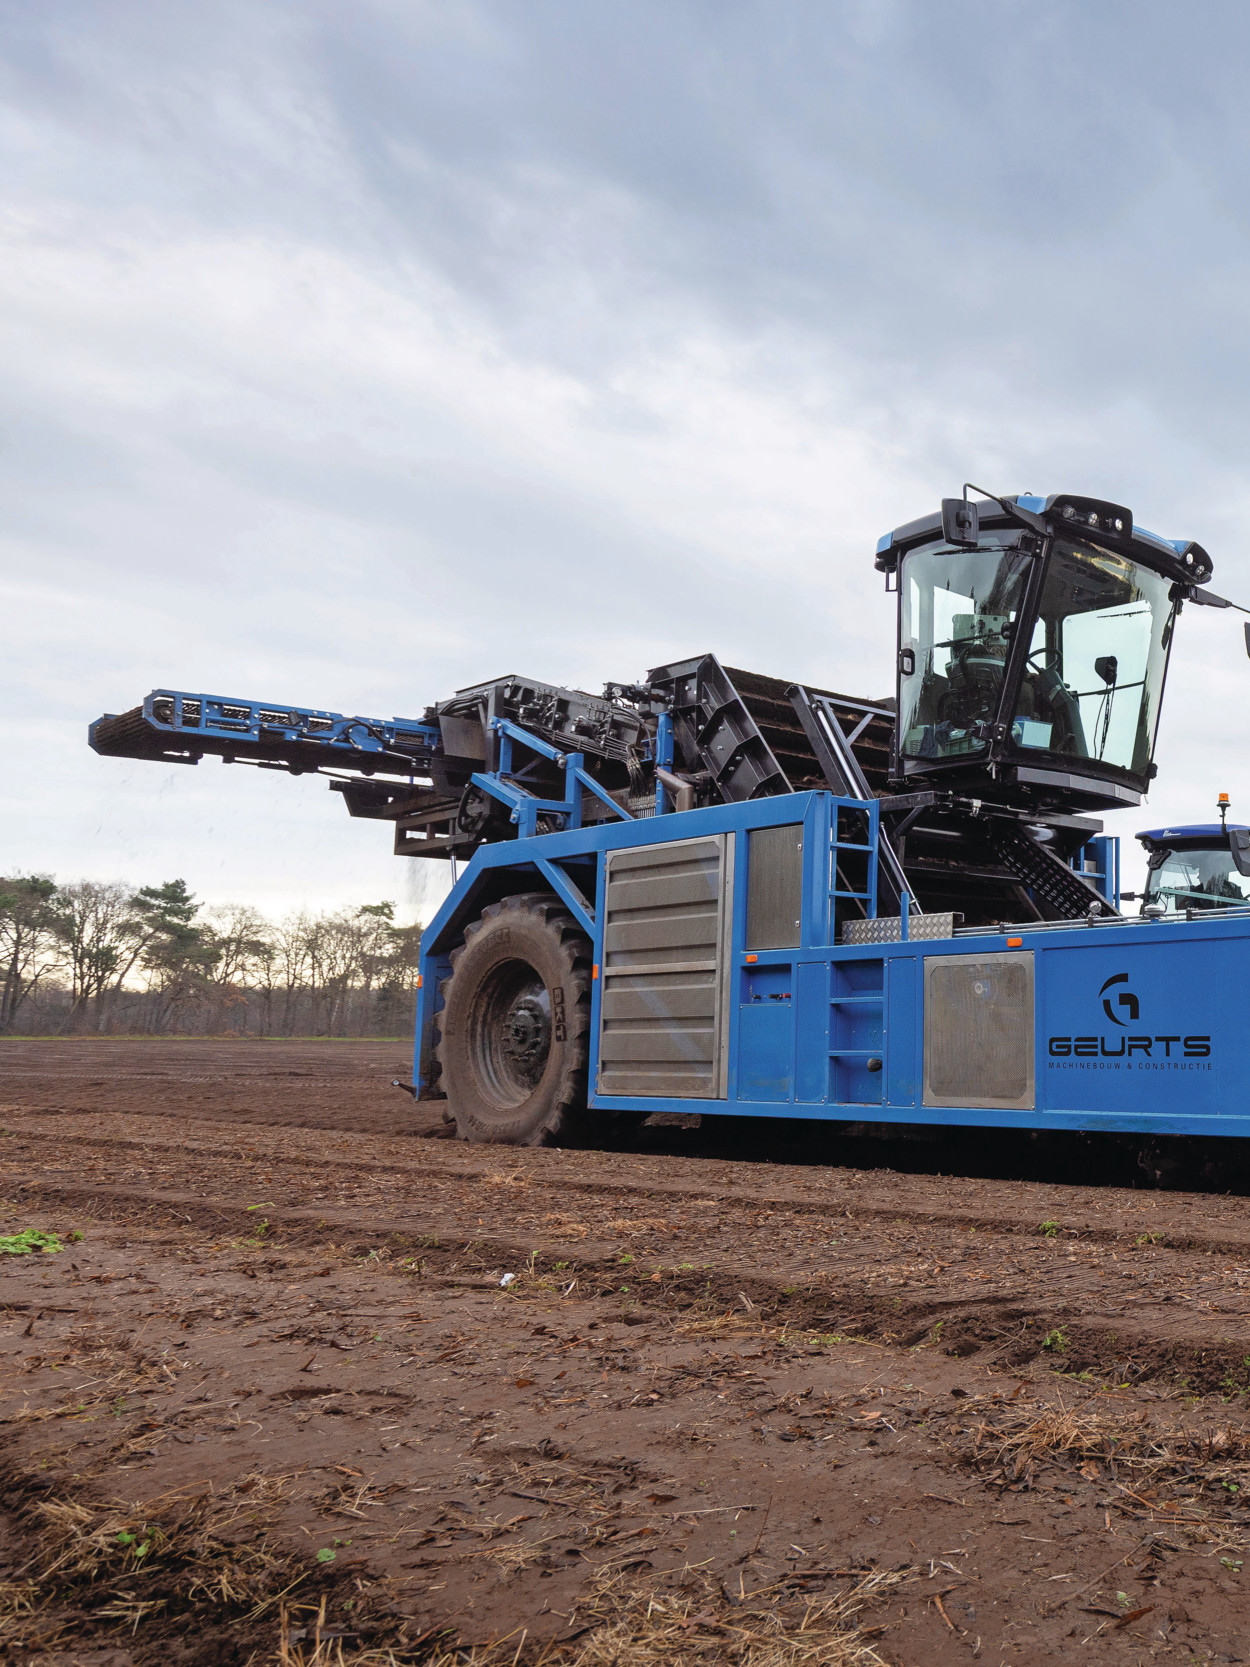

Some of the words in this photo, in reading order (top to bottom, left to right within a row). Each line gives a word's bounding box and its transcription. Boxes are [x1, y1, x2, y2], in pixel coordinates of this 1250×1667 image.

[552, 987, 568, 1042] BKT
[1049, 1036, 1211, 1057] GEURTS
[1048, 1062, 1121, 1070] MACHINEBOUW
[1126, 1062, 1133, 1070] &
[1138, 1062, 1212, 1071] CONSTRUCTIE
